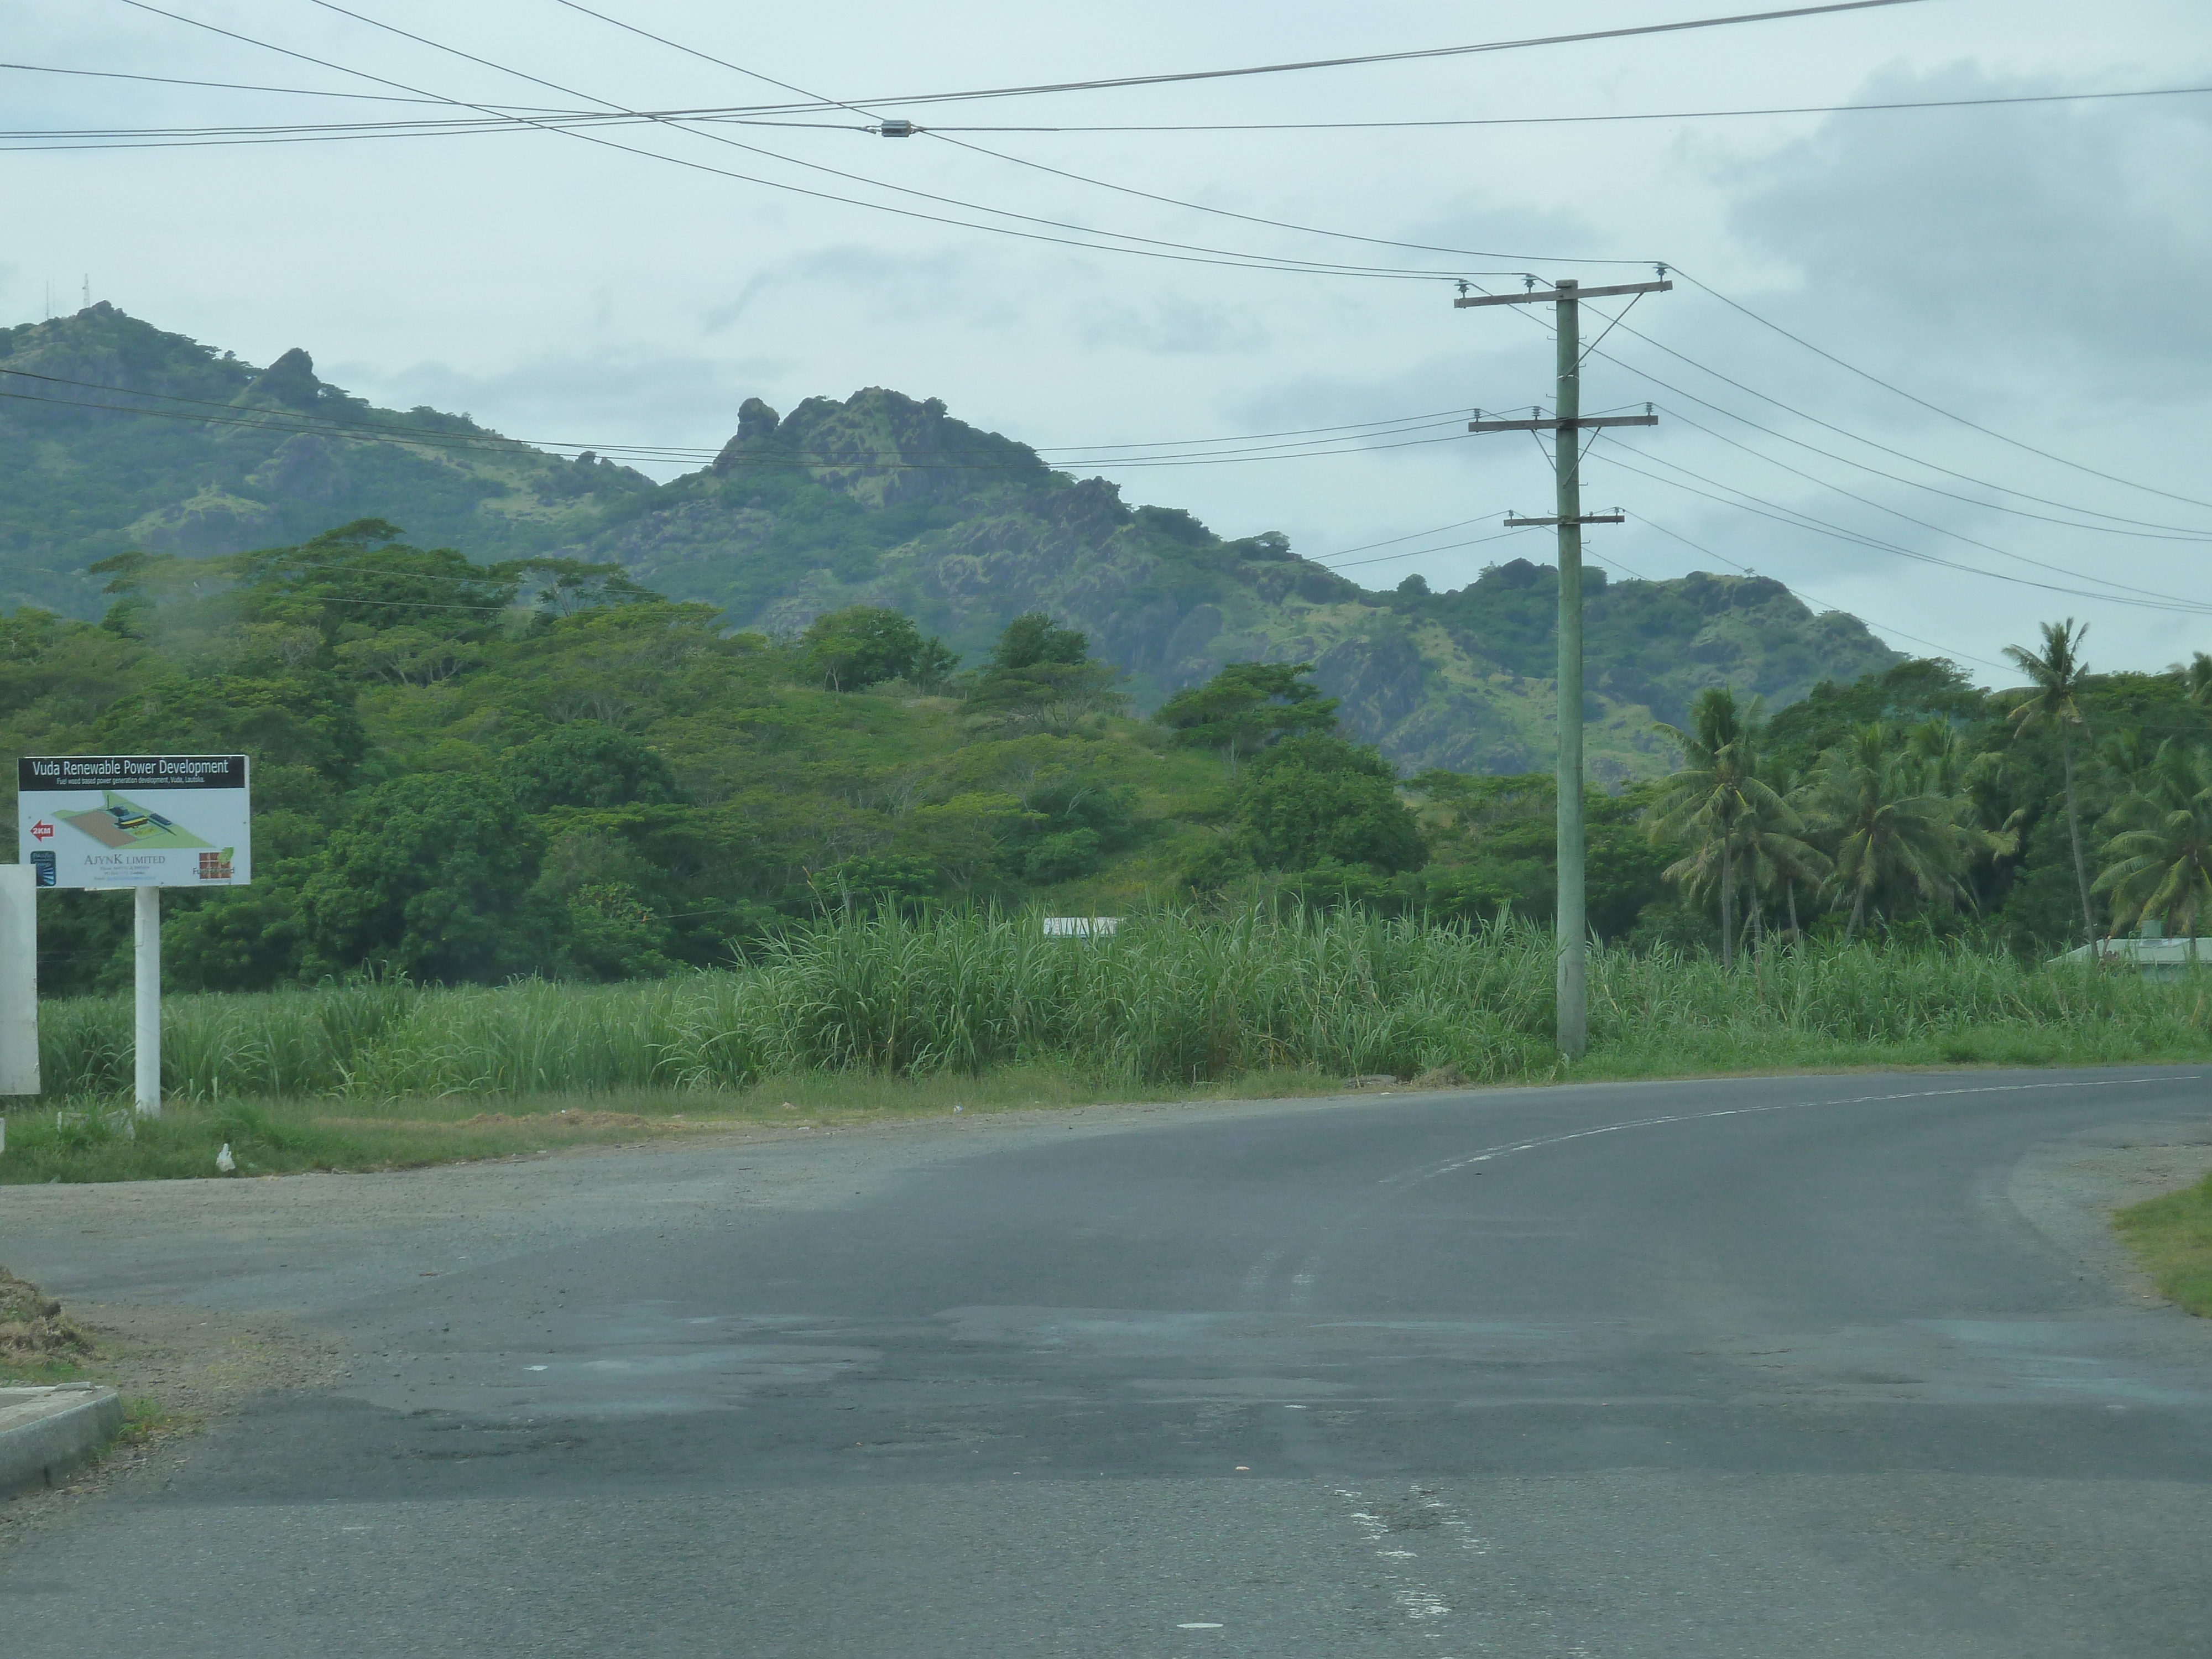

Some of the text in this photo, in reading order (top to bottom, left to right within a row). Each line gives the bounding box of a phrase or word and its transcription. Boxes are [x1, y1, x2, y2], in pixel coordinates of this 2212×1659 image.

[33, 759, 228, 776] Vuda Renewable Power Development
[112, 777, 137, 785] generation
[126, 855, 165, 864] LIMITED
